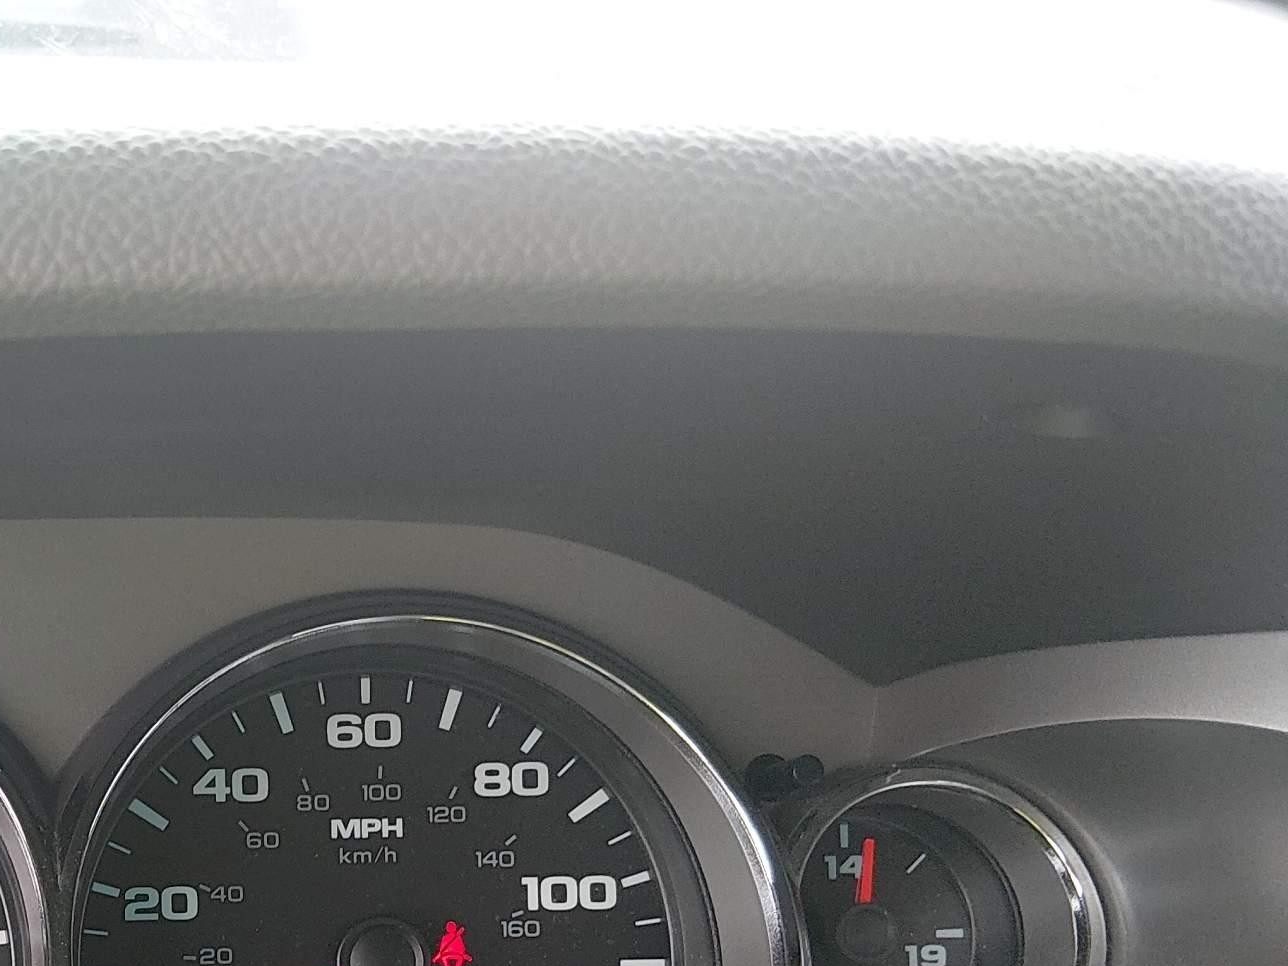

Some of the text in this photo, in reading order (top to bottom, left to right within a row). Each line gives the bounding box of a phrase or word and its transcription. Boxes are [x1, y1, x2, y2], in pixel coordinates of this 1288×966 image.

[326, 713, 402, 748] 60
[192, 768, 269, 802] 40
[474, 762, 550, 797] 80
[361, 784, 402, 801] 100
[296, 794, 330, 812] 80
[427, 806, 467, 824] 120
[330, 818, 404, 840] MPH
[246, 831, 280, 850] 60
[338, 846, 398, 864] km/h
[475, 850, 516, 868] 140
[824, 855, 863, 880] 14
[210, 886, 244, 904] 40
[521, 876, 616, 910] 100
[124, 886, 199, 921] 20
[501, 920, 540, 938] 160
[198, 948, 233, 965] 20
